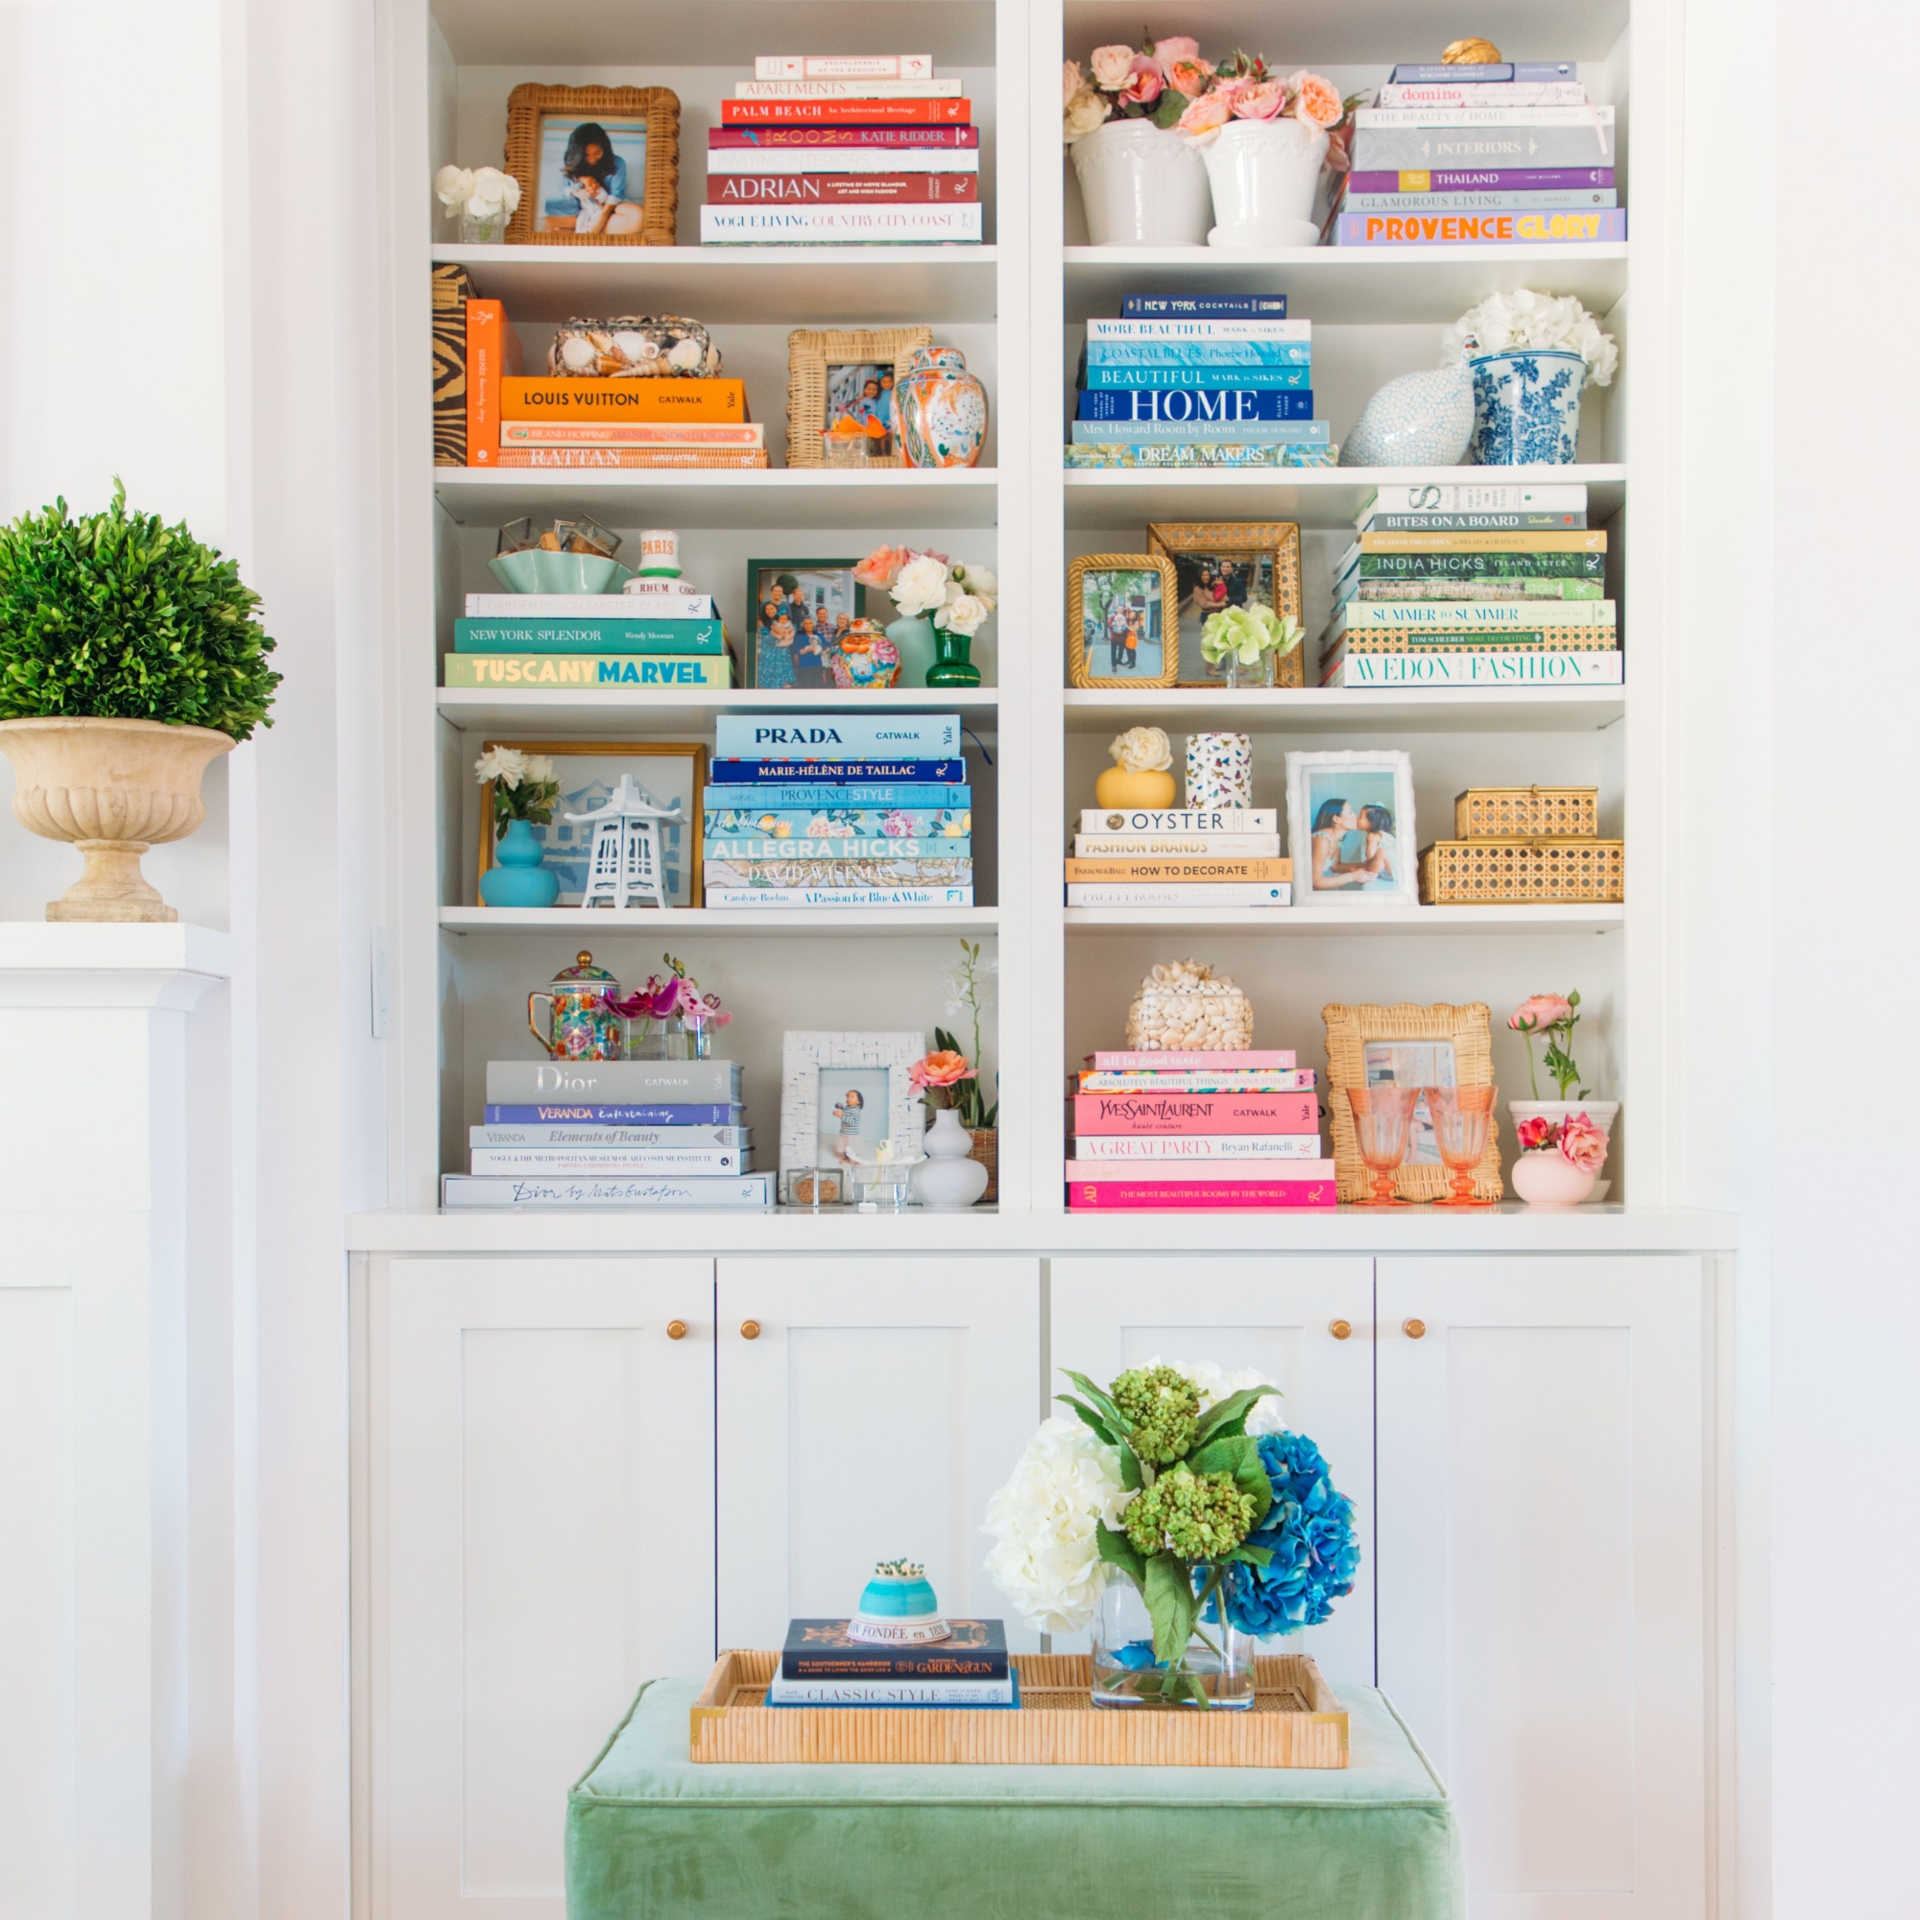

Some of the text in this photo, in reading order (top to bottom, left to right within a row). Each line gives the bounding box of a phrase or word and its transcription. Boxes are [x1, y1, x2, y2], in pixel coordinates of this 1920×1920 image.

[746, 83, 846, 95] APARTMENTS
[1402, 88, 1461, 100] domino
[733, 106, 769, 116] PALM
[775, 106, 821, 116] BEACH
[1372, 111, 1506, 122] THE BEAUTY of HOME
[773, 130, 854, 144] ROOMS
[861, 131, 896, 142] KATIE
[899, 131, 946, 142] RIDDER
[1436, 141, 1522, 155] INTERIORS
[719, 154, 869, 166] INVITING INTERIORS
[1436, 173, 1499, 184] THAILAND
[722, 179, 820, 198] ADRIAN
[1361, 195, 1502, 207] GLAMOROUS LIVING
[714, 215, 954, 226] VOGUE LIVING COAST
[1366, 214, 1601, 240] PROVENCE GLORY
[1144, 301, 1167, 310] NEW
[1171, 301, 1196, 310] YORK
[1097, 324, 1215, 334] MORE BEAUTIFUL
[1210, 348, 1281, 358] Phoebe Howard
[1101, 370, 1205, 383] BEAUTIFUL
[524, 392, 639, 406] LOUIS VUITTON
[658, 396, 702, 404] CATWALK
[727, 391, 735, 409] Yale
[1129, 390, 1259, 421] HOME
[531, 430, 610, 439] ISLAND HOPPING
[1083, 423, 1235, 437] Mrs. Howard Room by Room
[529, 450, 621, 465] RATTAN
[1138, 448, 1194, 461] DREAM
[1201, 447, 1265, 461] MAKERS
[1387, 515, 1519, 527] BITES ON A BOARD
[642, 540, 674, 556] PARIS
[1377, 558, 1484, 570] INDIA HICKS
[640, 583, 669, 592] RHUM
[1373, 609, 1436, 621] SUMMER
[1440, 610, 1452, 618] TO
[1455, 608, 1518, 620] SUMMER
[470, 630, 602, 641] NEW YORK SPLENDOR
[625, 632, 646, 640] Wendy
[472, 659, 596, 682] TUSCANY
[599, 662, 707, 684] MARVEL
[1354, 658, 1451, 680] AVEDON
[1472, 656, 1583, 679] FASHION
[755, 728, 843, 744] PRADA
[943, 726, 952, 745] Yale
[758, 765, 916, 776] MARIE-HÉLÈNE DE TAILLAC
[1132, 813, 1224, 829] OYSTER
[712, 840, 834, 858] ALLEGRA
[843, 839, 920, 857] HICKS
[1085, 839, 1147, 853] FASHION
[1151, 839, 1208, 853] BRANDS
[748, 866, 898, 881] DAVID WISEMAN
[1131, 867, 1160, 876] HOW
[1164, 867, 1180, 875] TO
[1184, 866, 1248, 875] DECORATE
[724, 893, 789, 904] Carolyne Roehm
[804, 892, 933, 903] A Passion for Blue & White
[1103, 1056, 1201, 1068] all in good taste
[533, 1066, 597, 1093] Dior
[645, 1078, 689, 1086] CATWALK
[1098, 1079, 1148, 1087] ABSOLUTELY
[1150, 1078, 1193, 1086] BEAUTIFUL
[1234, 1077, 1259, 1085] ANNA
[538, 1106, 673, 1123] VERANDA Entertaining
[1132, 1122, 1182, 1130] haute couture
[487, 1133, 526, 1142] VERANDA
[548, 1131, 660, 1144] Elements of Beauty
[1086, 1140, 1214, 1155] A GREAT PARTY
[1221, 1142, 1293, 1154] Bryan Rafanelli
[513, 1182, 692, 1201] Dior by Mats Gustafson
[862, 1625, 926, 1639] FONDÉE en
[807, 1689, 882, 1702] CLASSIC
[887, 1689, 941, 1701] STYLE
